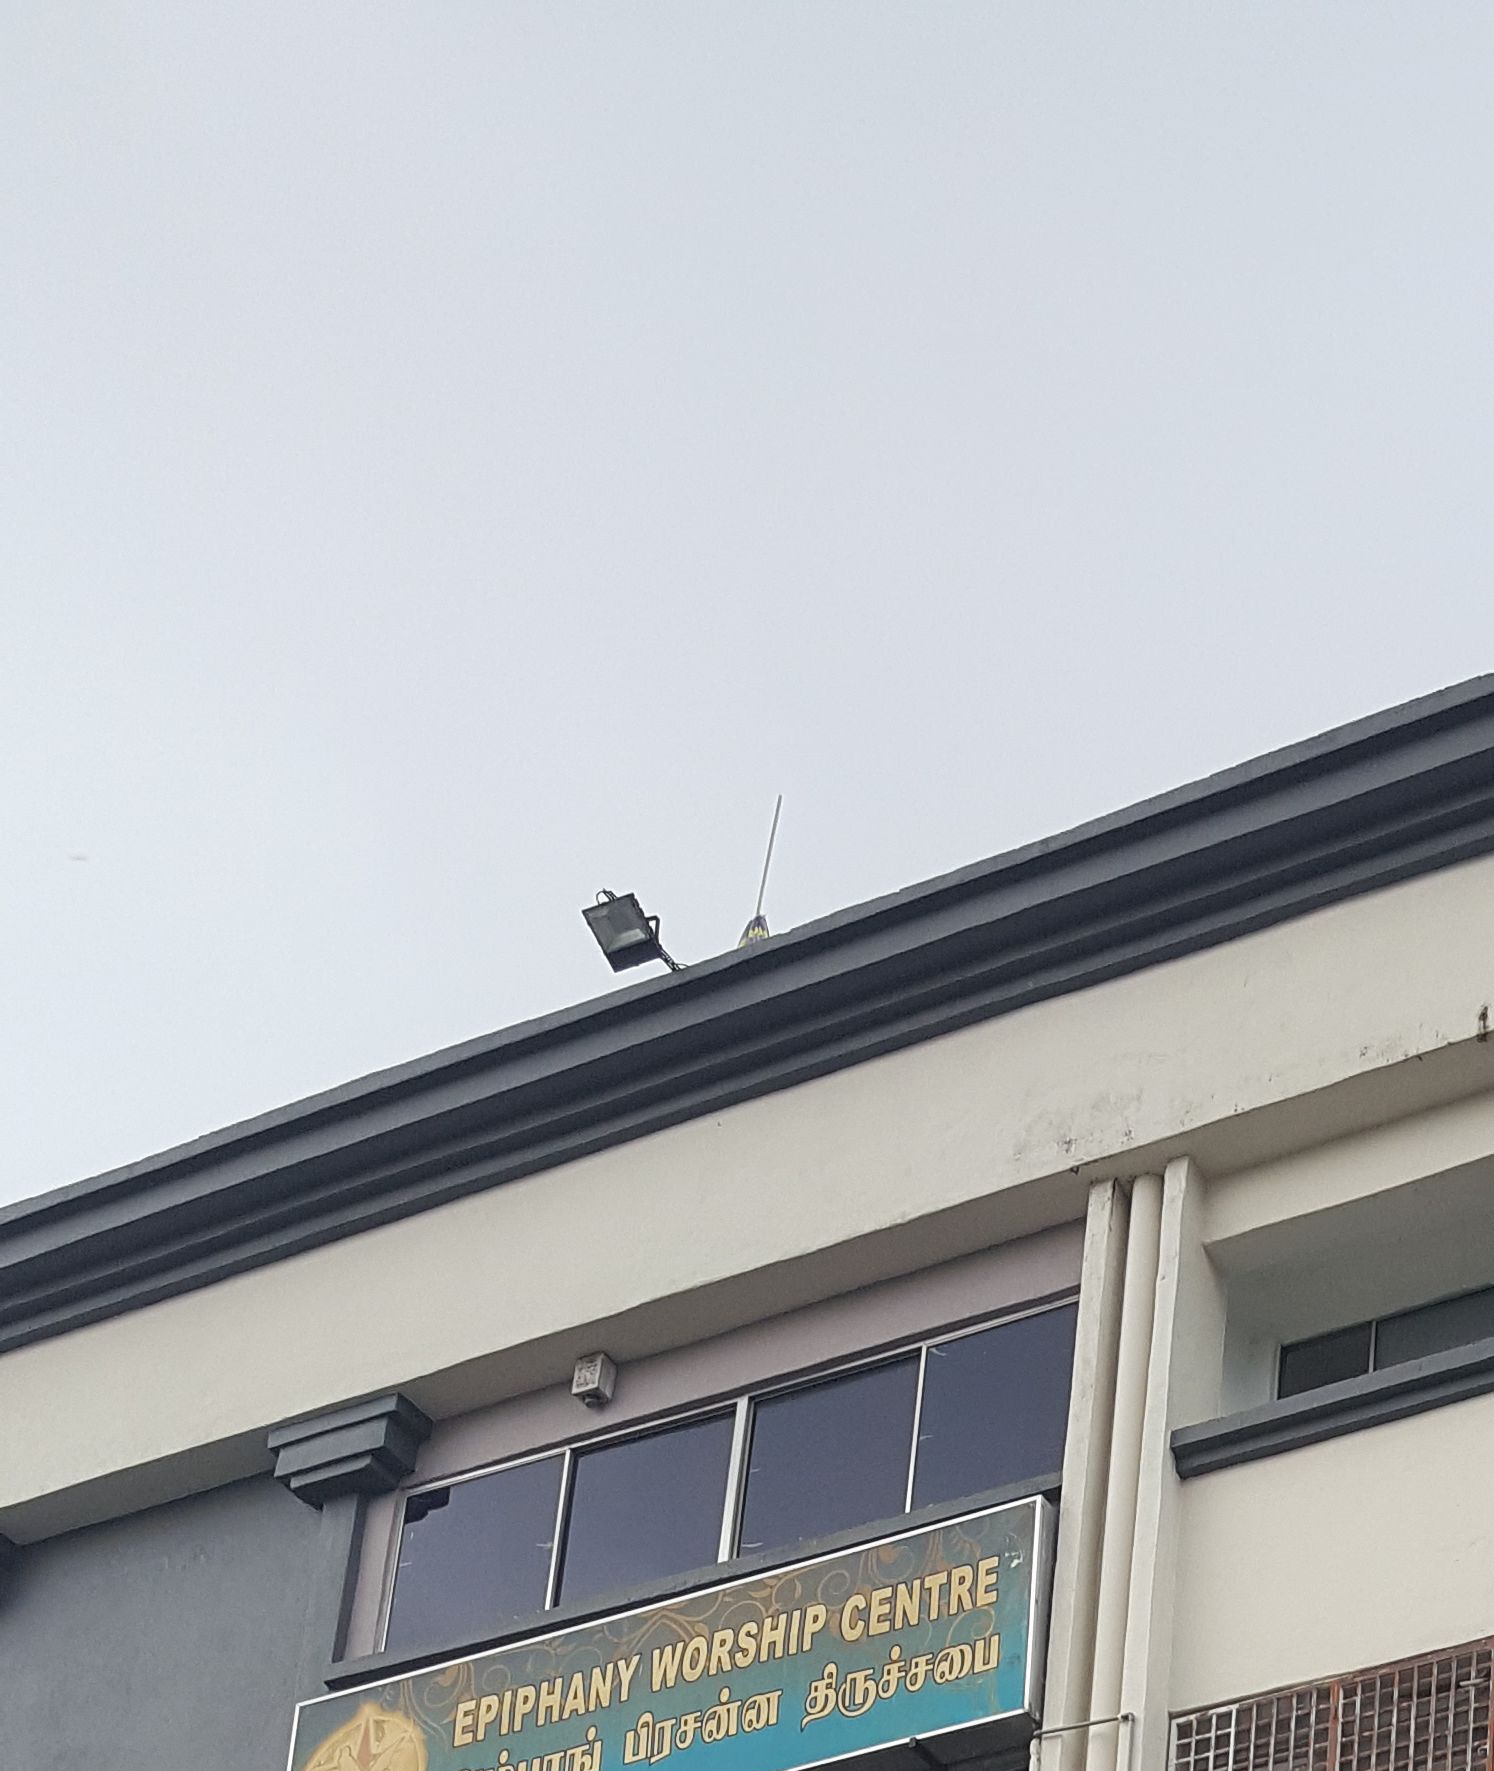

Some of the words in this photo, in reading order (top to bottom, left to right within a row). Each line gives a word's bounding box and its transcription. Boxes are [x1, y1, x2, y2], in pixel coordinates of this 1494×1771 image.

[452, 1653, 641, 1748] EPIPHANY
[650, 1603, 827, 1692] WORSHIP
[841, 1556, 999, 1642] CENTRE
[623, 1687, 783, 1765] பிரசன்ன
[801, 1634, 1000, 1733] திருச்சபை
